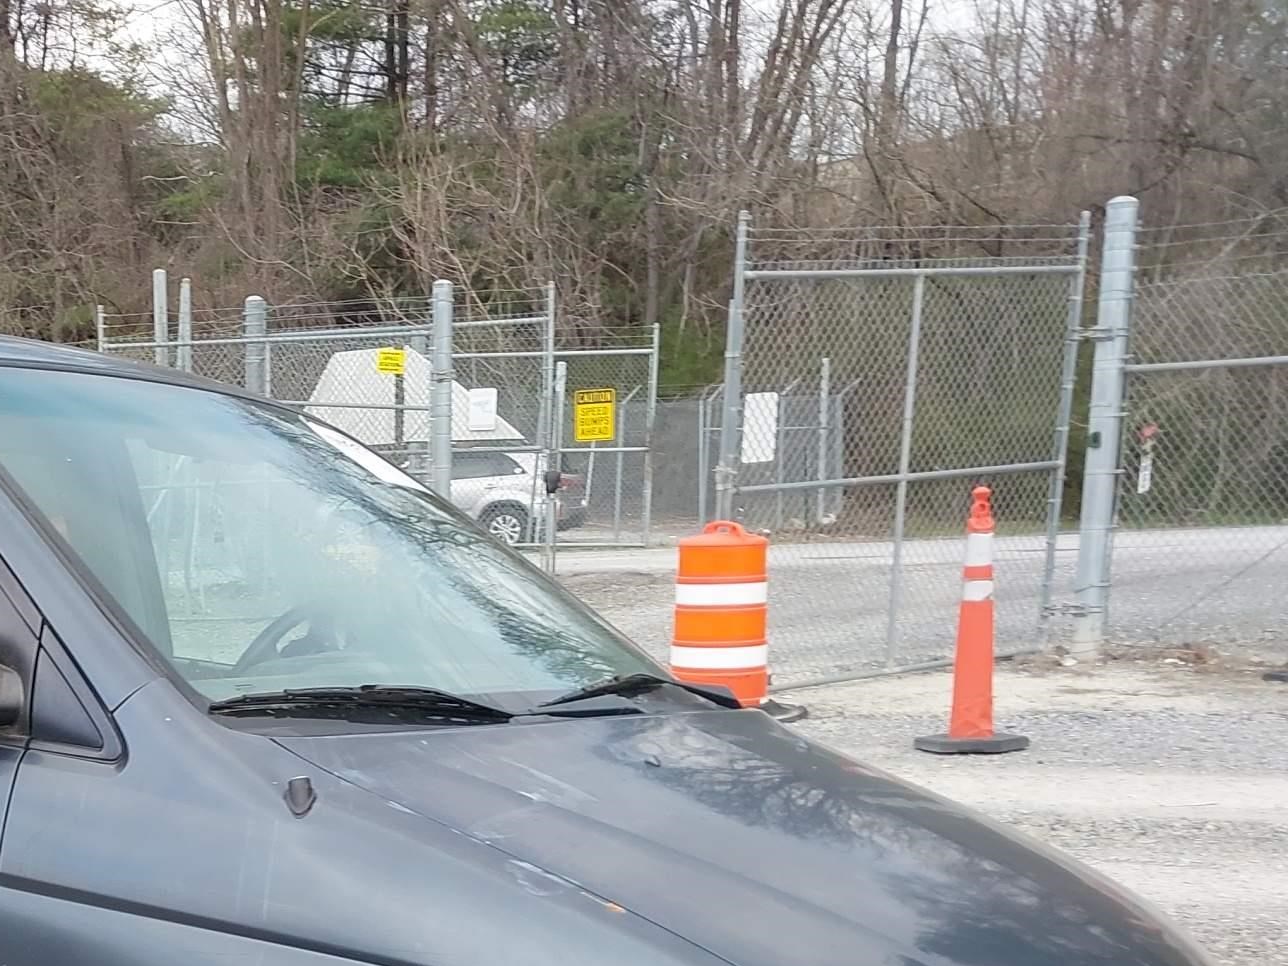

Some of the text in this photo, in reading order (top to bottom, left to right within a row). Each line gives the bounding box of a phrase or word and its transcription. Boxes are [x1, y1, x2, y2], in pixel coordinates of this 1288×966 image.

[580, 406, 608, 416] SPEED
[579, 416, 609, 426] BUMPS
[580, 427, 609, 436] AHEAD
